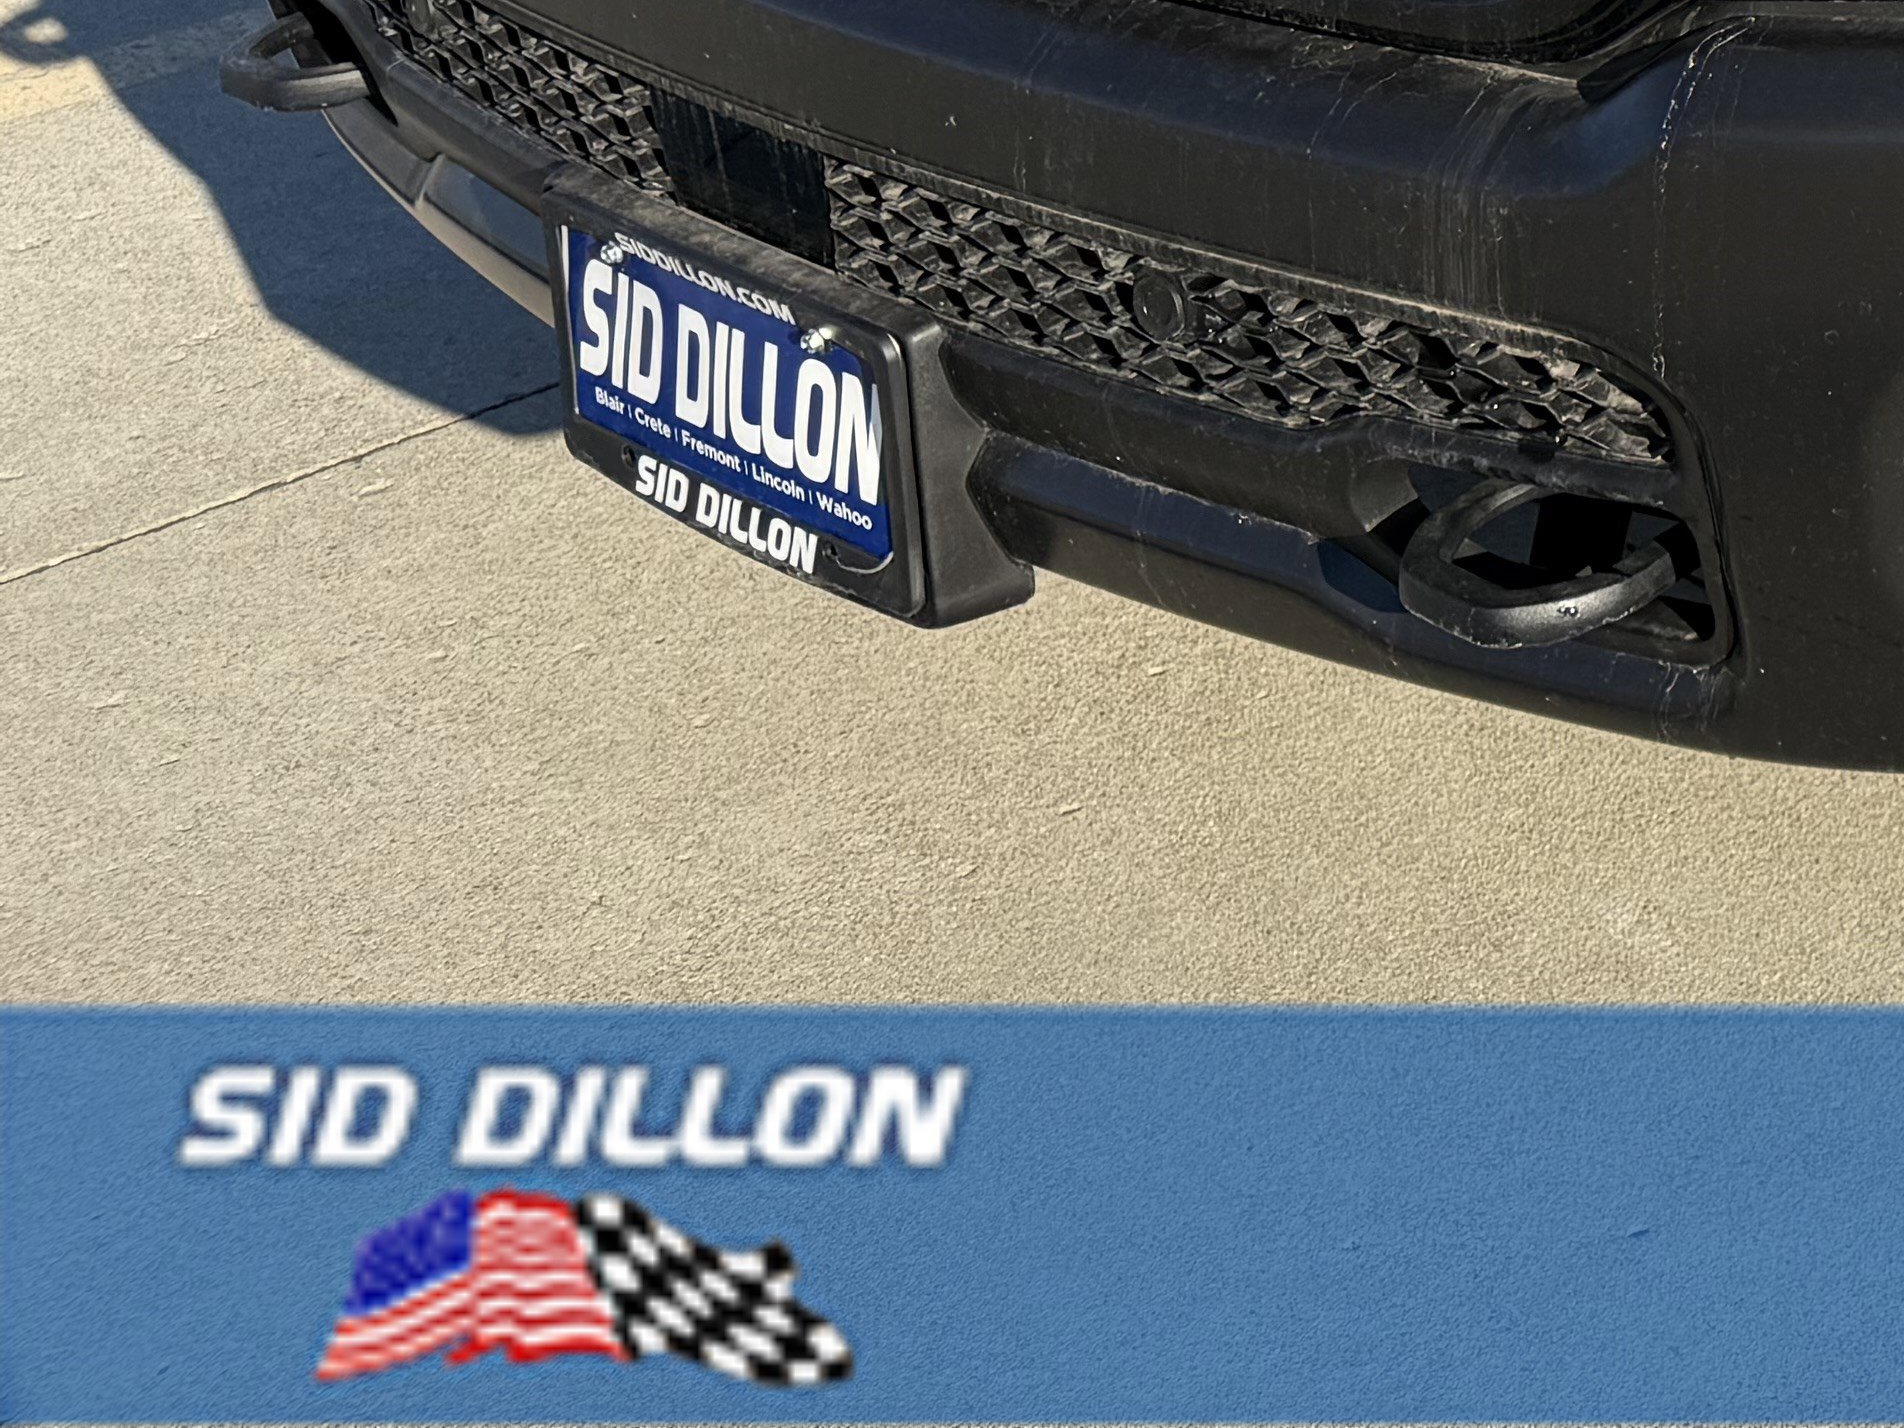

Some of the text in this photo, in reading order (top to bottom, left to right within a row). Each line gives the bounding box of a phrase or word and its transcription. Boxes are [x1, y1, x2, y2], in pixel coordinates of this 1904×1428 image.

[613, 231, 797, 326] SIDDILLON.COM
[579, 258, 884, 506] SID DILLON
[595, 386, 873, 532] Blair Crete Fremont Lincoln Wahoo
[635, 454, 819, 575] SID DILLON
